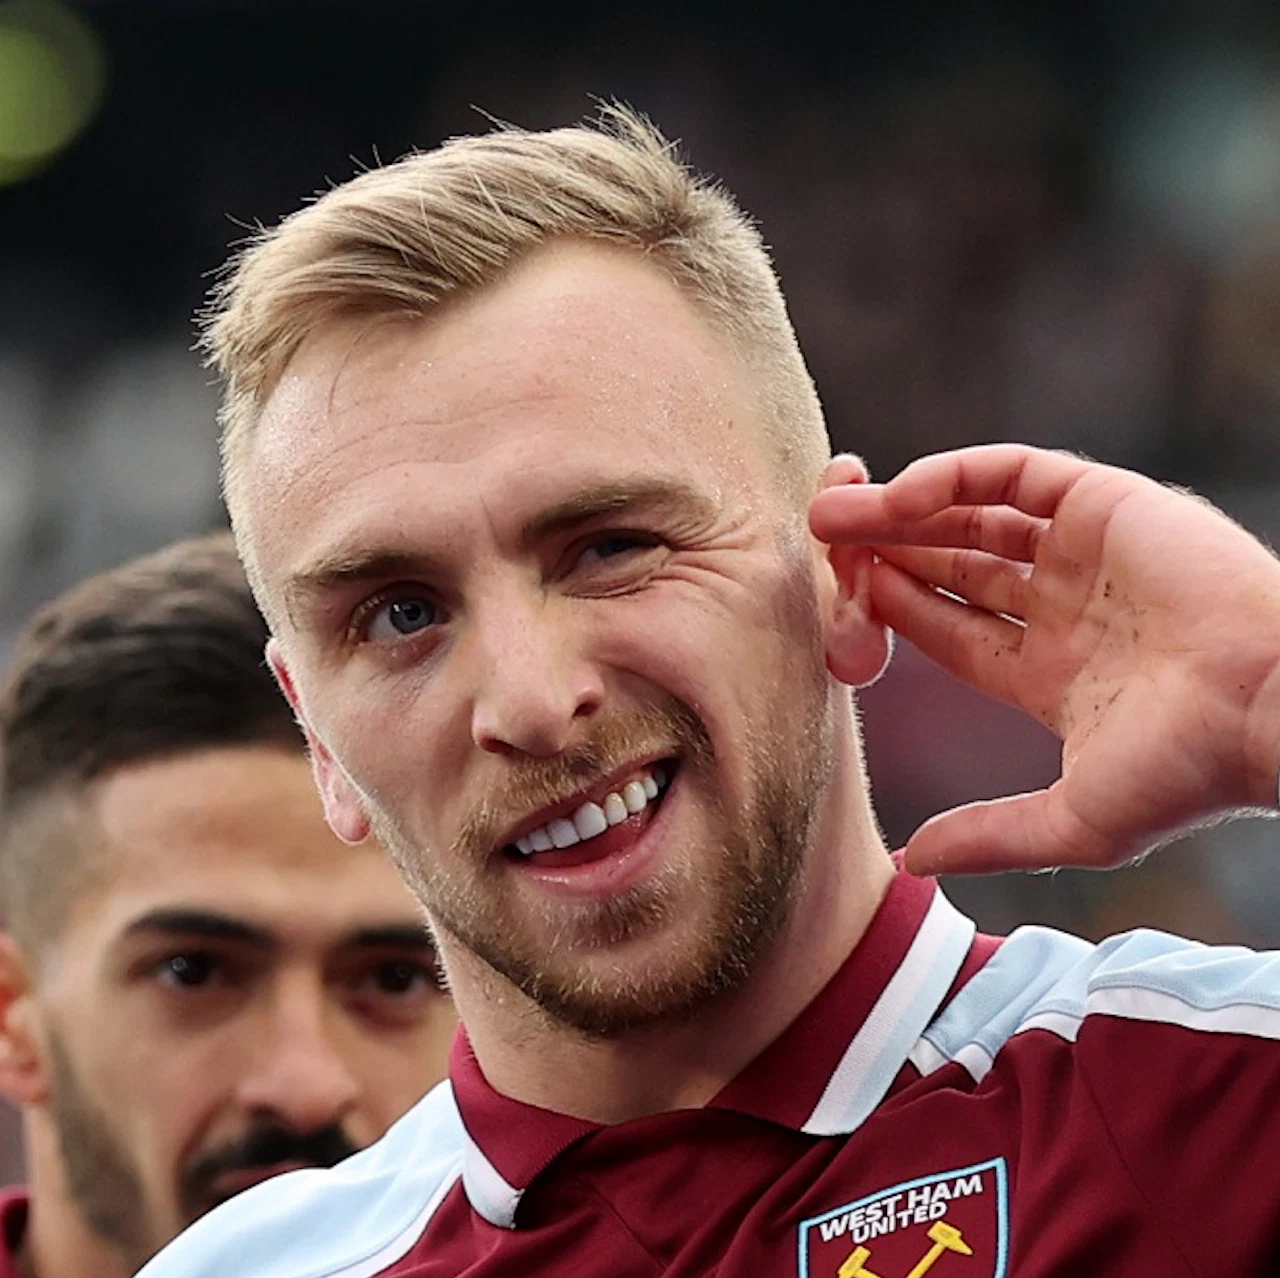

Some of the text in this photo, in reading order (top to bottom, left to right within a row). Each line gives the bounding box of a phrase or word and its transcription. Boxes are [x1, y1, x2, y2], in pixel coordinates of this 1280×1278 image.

[820, 1174, 984, 1242] WEST HAM
[852, 1201, 948, 1244] UNITED
